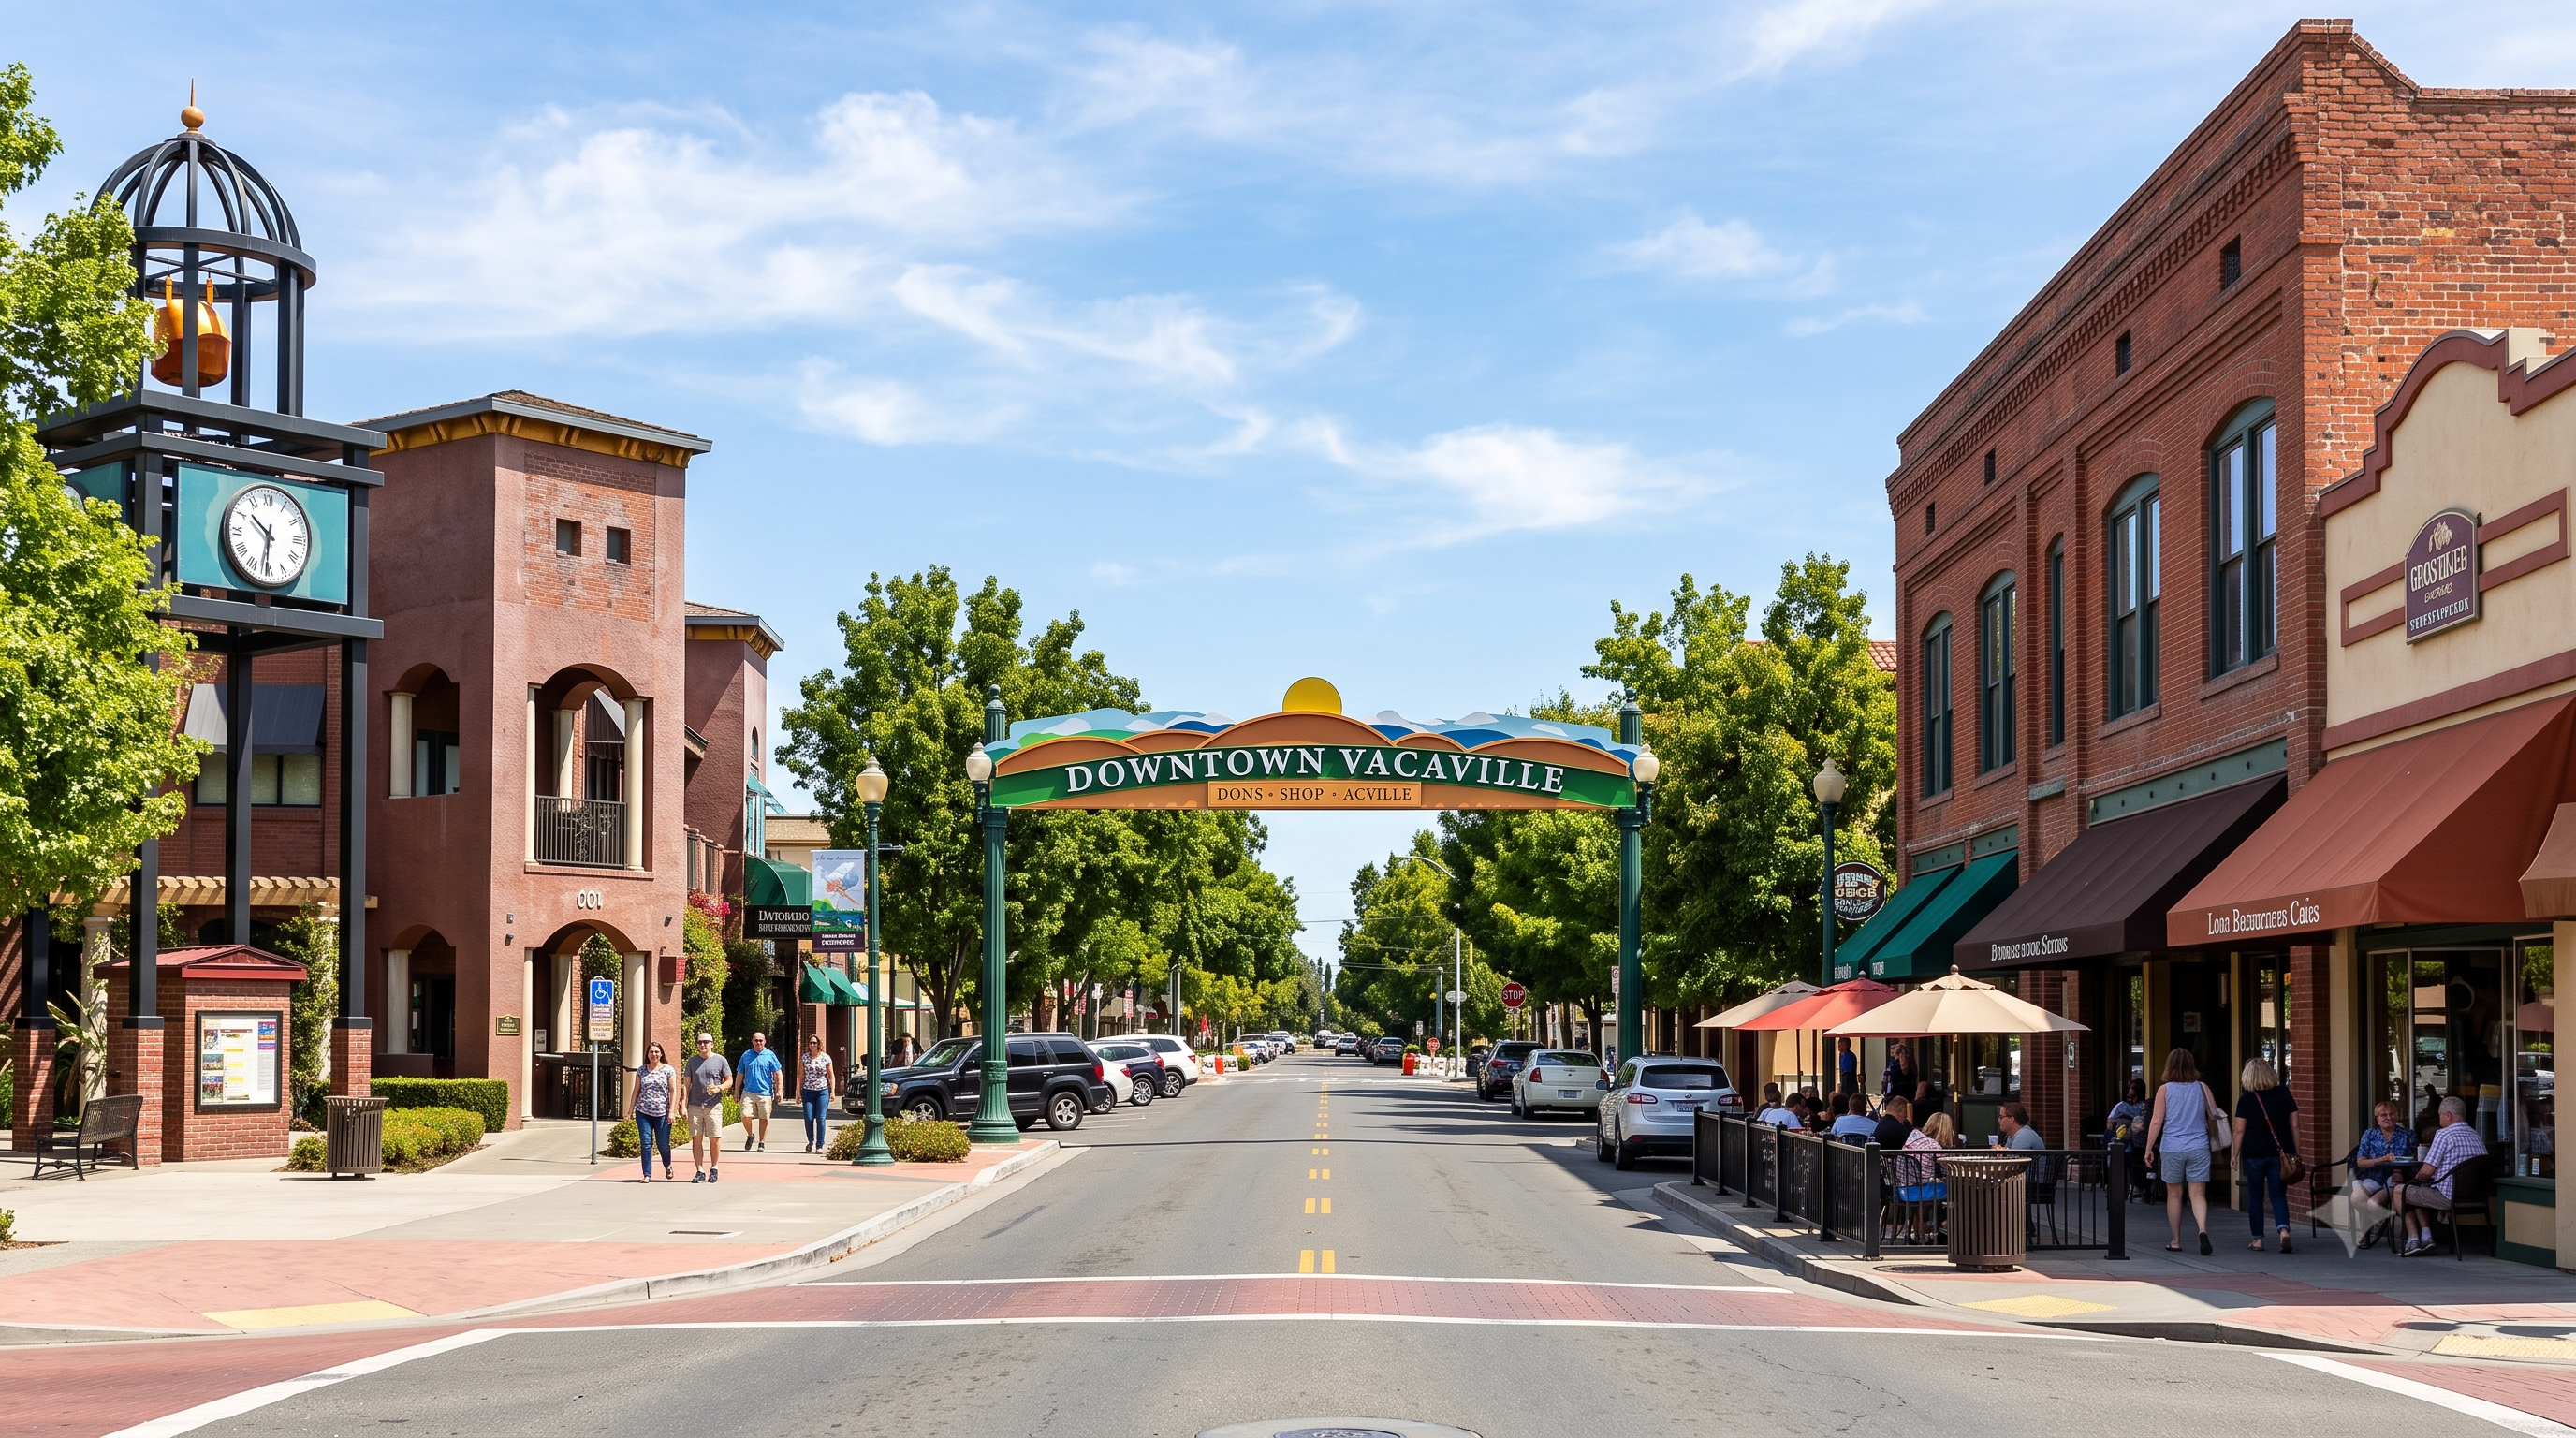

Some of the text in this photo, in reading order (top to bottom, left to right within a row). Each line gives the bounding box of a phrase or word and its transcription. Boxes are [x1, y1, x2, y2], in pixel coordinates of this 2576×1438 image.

[1065, 747, 1564, 795] DOWNTOWN VACAVILLE
[1217, 787, 1412, 800] DONS SHOP ACVILLE
[1502, 990, 1524, 1000] STOP
